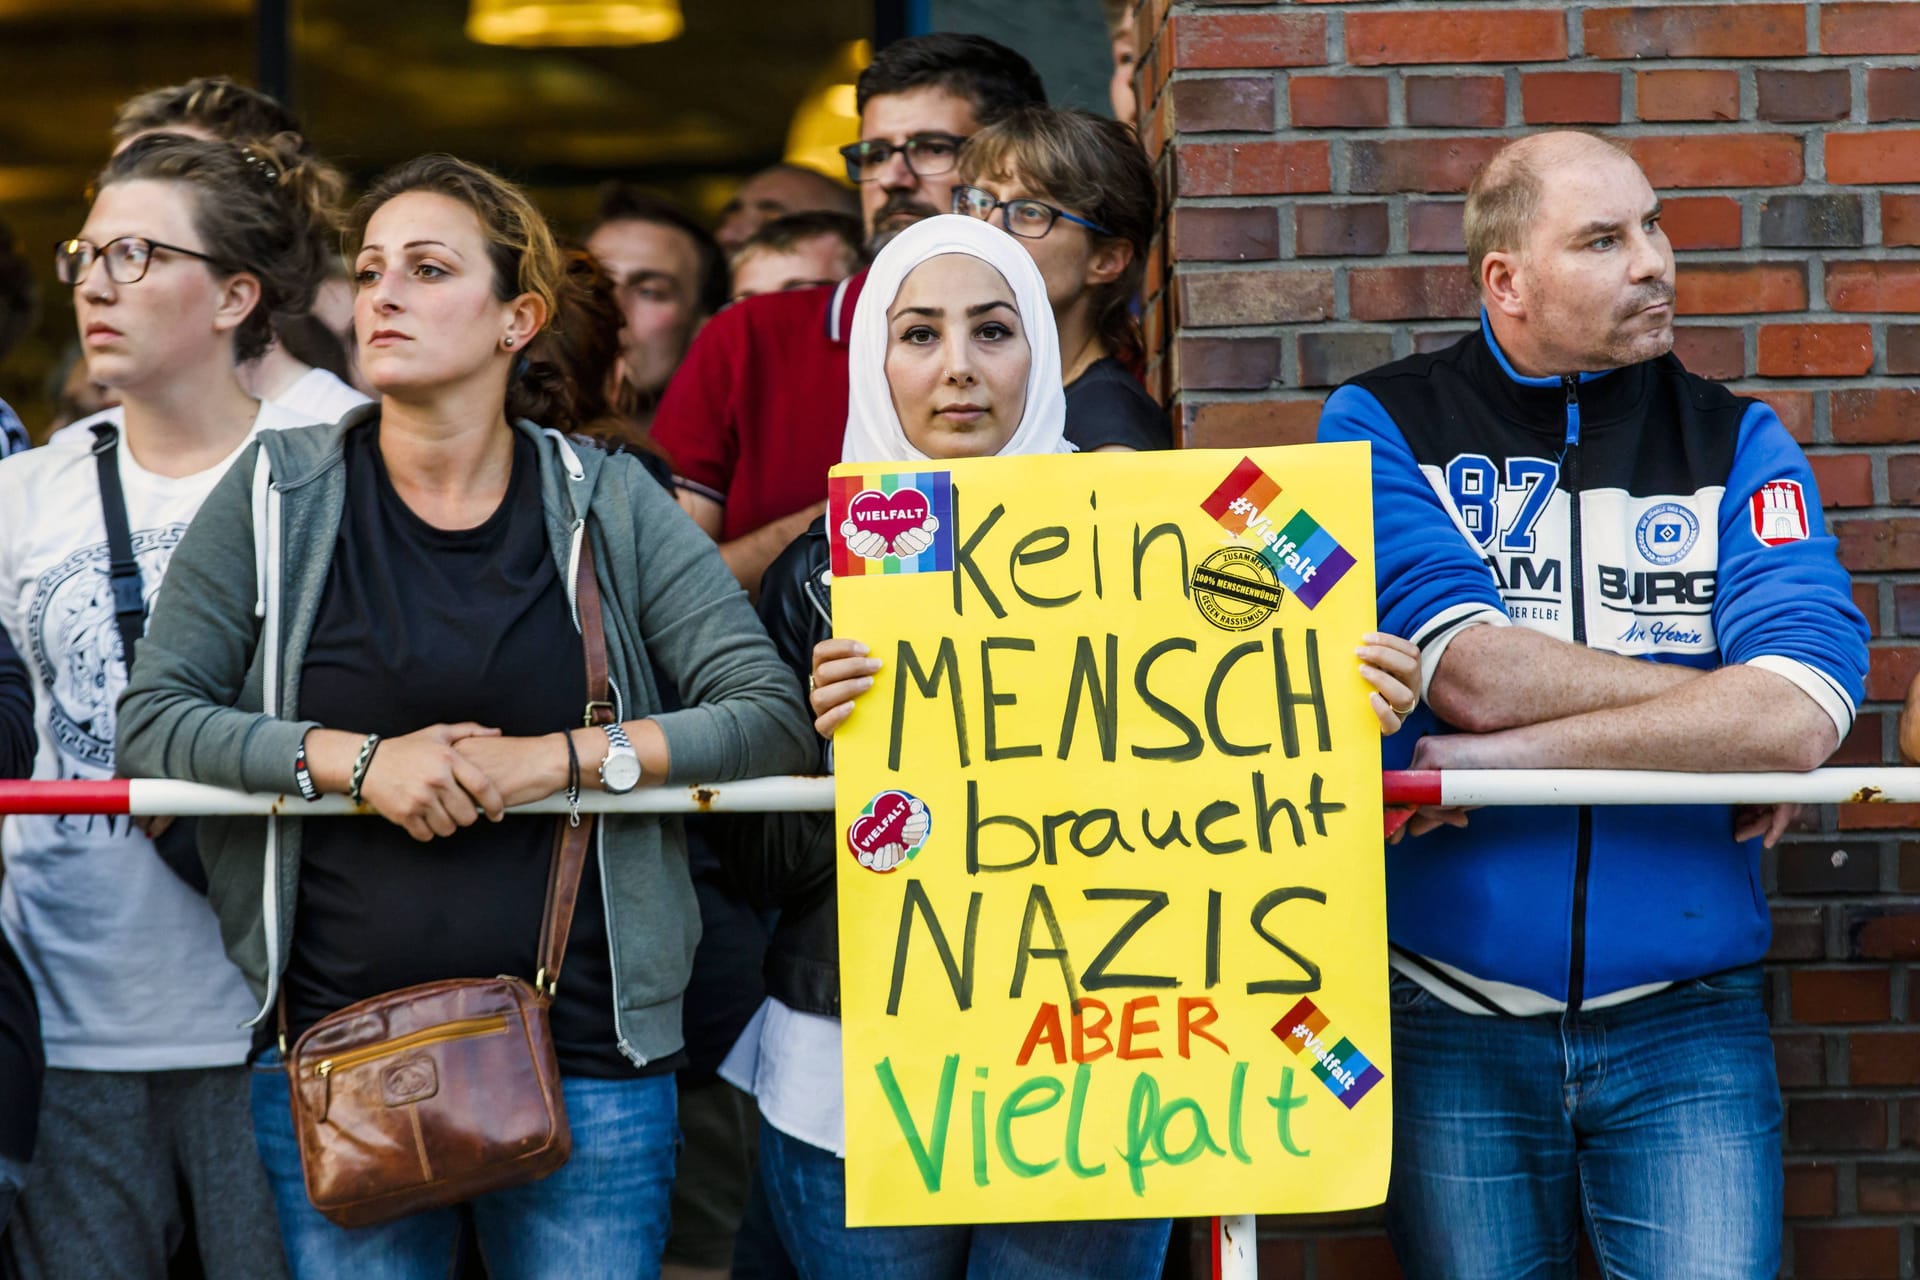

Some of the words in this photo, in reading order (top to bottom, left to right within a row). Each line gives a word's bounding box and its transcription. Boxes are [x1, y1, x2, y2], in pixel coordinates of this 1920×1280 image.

[856, 508, 924, 522] VIELFALT
[1445, 453, 1560, 553] 87
[1223, 552, 1265, 571] ZUSAMMEN
[1228, 497, 1317, 583] #Vielfalt
[1196, 573, 1216, 586] 100%
[1216, 578, 1279, 603] MENSCHENWÜRDE
[1202, 595, 1219, 618] GEGEN
[1220, 609, 1264, 625] RASSISMUS
[1509, 606, 1527, 618] DER
[1532, 607, 1559, 620] ELBE
[1597, 564, 1718, 605] BURG
[888, 629, 1332, 772] MENSCH
[861, 801, 906, 847] VIELFALT
[966, 771, 1346, 876] braucht
[887, 879, 1327, 1016] NAZIS
[1016, 996, 1229, 1066] ABER
[1292, 1024, 1355, 1090] #Vielfalt
[875, 1054, 1311, 1197] Vielfalt
